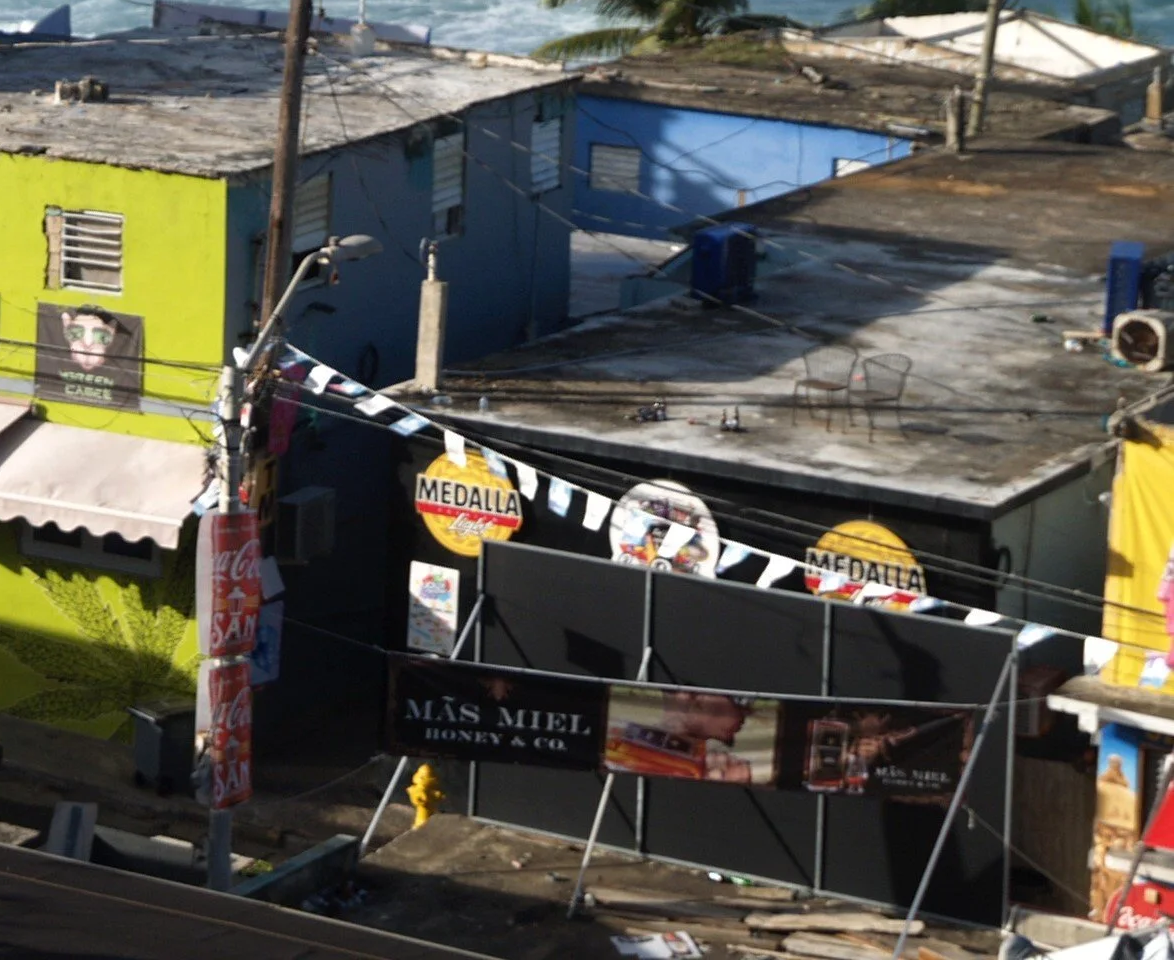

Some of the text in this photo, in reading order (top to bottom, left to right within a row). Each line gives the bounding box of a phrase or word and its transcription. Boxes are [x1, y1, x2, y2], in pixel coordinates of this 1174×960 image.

[417, 476, 521, 516] MEDALLA
[806, 551, 923, 592] MEDALLA
[425, 727, 502, 746] HONEY
[511, 736, 527, 748] &
[497, 706, 591, 736] MIEL
